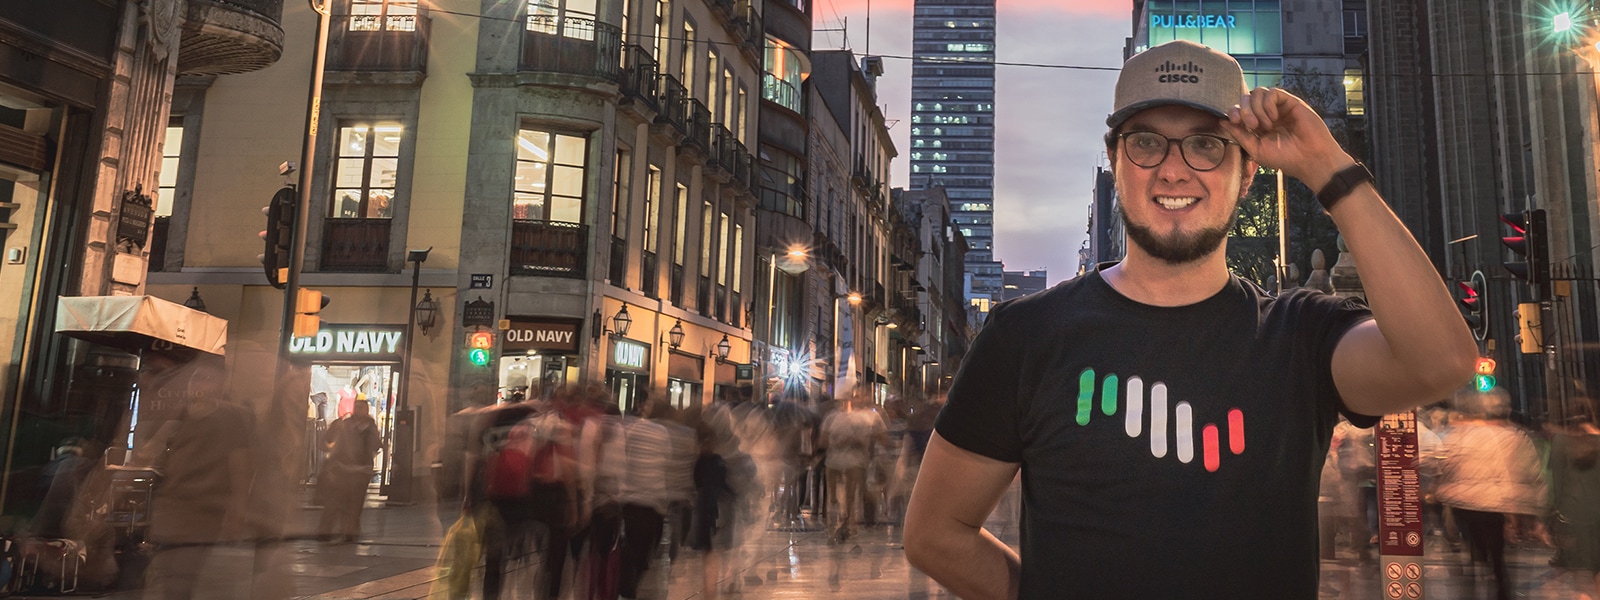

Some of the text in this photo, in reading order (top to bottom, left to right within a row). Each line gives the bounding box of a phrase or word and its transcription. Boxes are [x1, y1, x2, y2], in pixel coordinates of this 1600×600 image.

[1152, 15, 1235, 28] PULL&BEAR
[289, 330, 402, 354] OLD NAVY
[507, 329, 573, 343] OLD NAVY
